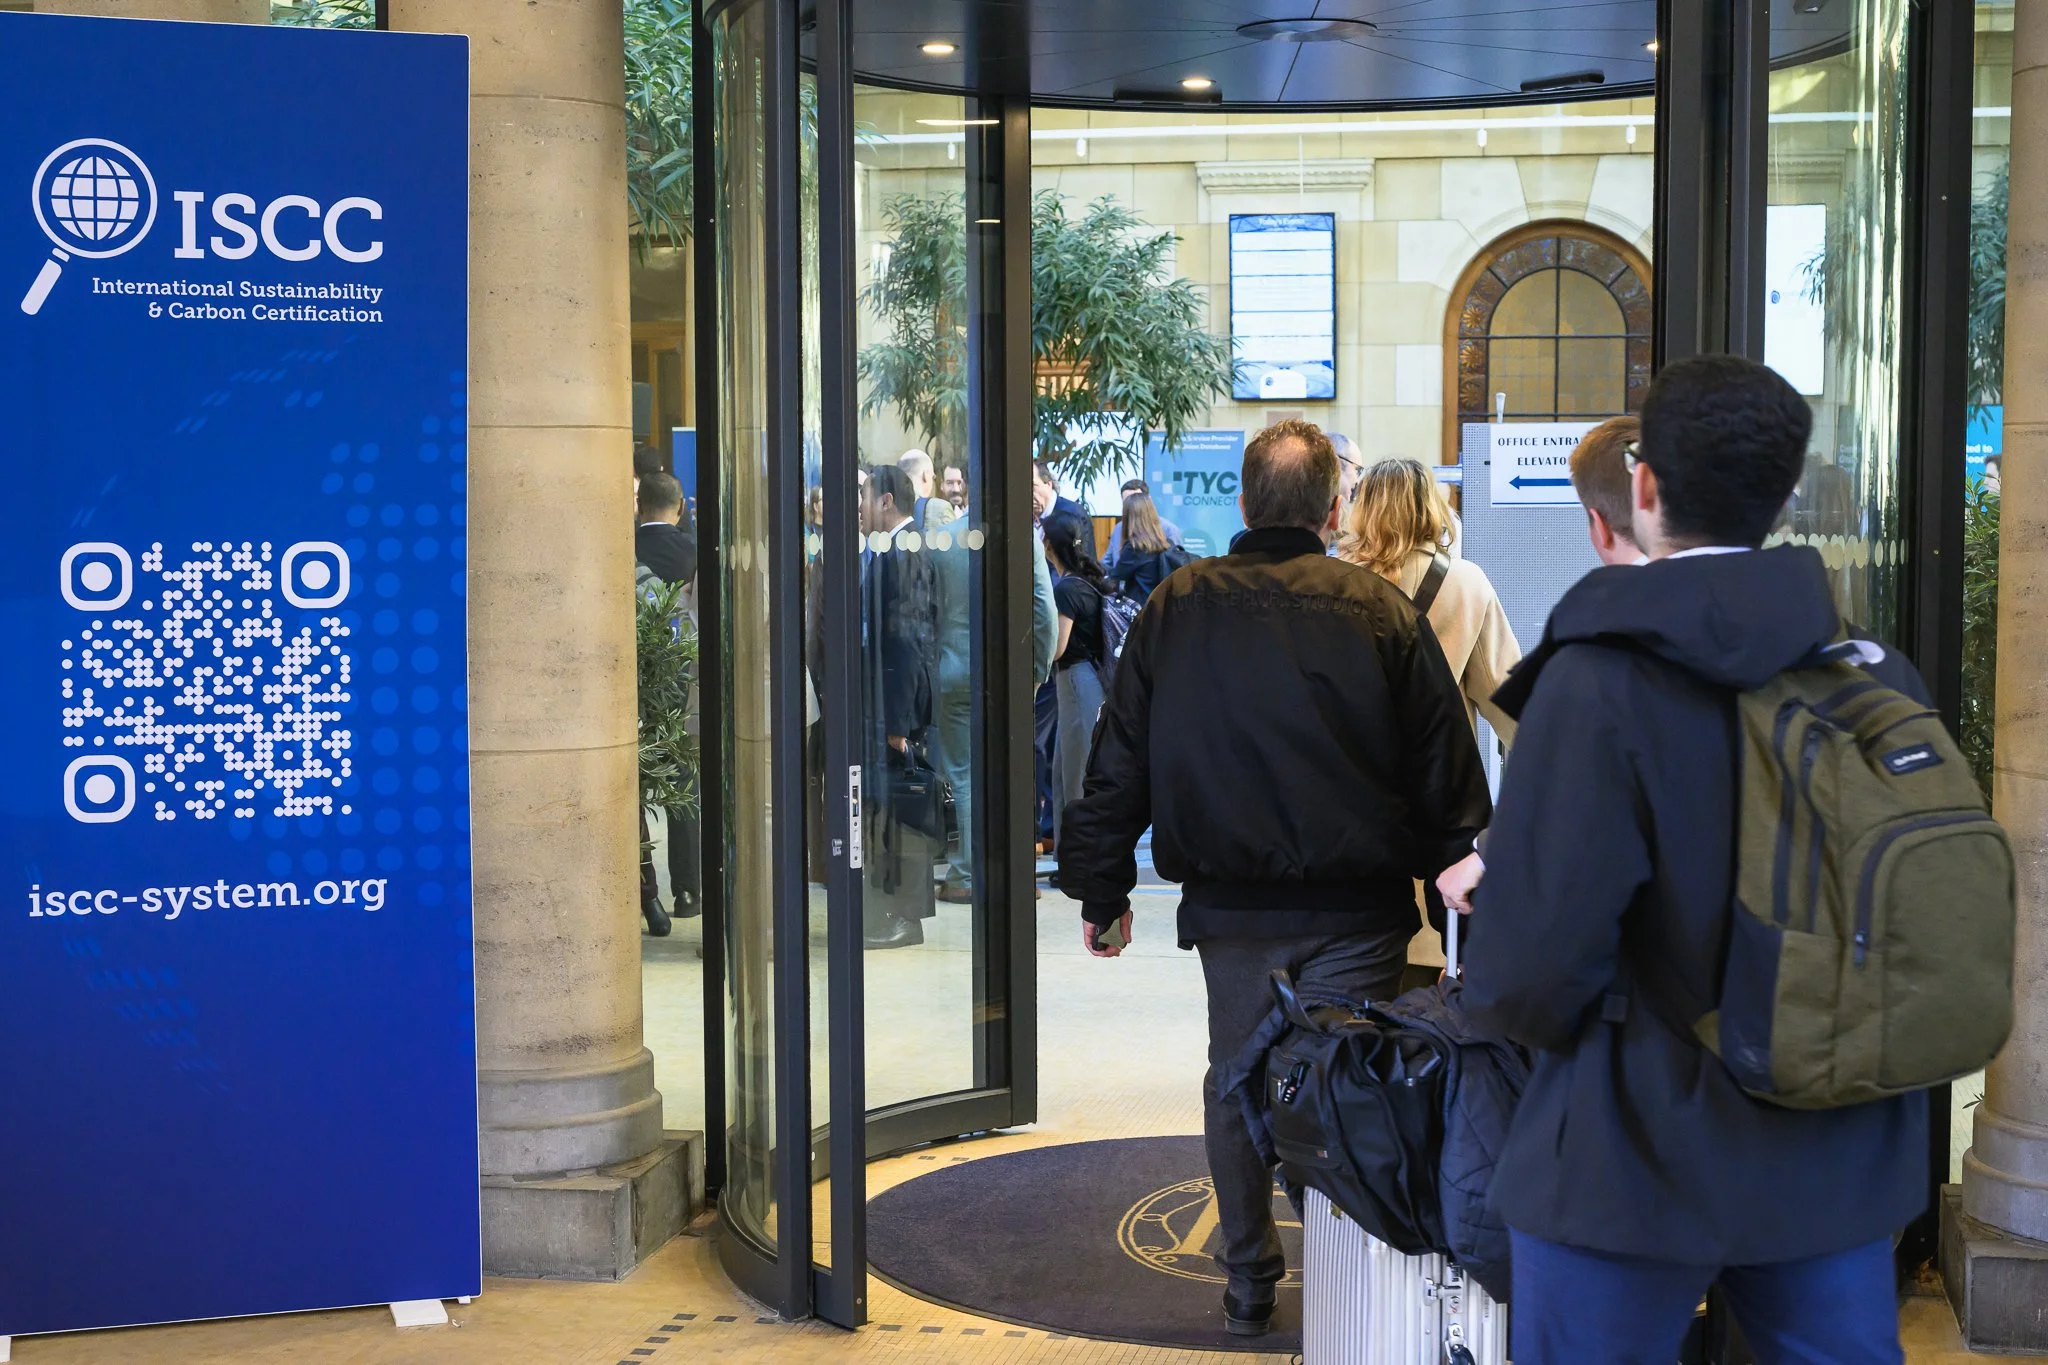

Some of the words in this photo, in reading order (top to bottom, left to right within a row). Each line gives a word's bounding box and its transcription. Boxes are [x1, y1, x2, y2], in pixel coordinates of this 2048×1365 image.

[173, 190, 384, 263] ISCC
[92, 277, 234, 297] International
[239, 280, 384, 303] Sustainability
[148, 302, 163, 318] &
[168, 302, 247, 320] Carbon
[251, 304, 384, 323] Certification
[1498, 437, 1538, 446] OFFICE
[1544, 437, 1579, 446] ENTRA
[1517, 457, 1567, 466] ELEVATO
[1183, 471, 1238, 495] TYC
[1183, 496, 1238, 506] CONNECT
[28, 878, 388, 921] iscc-system.org
